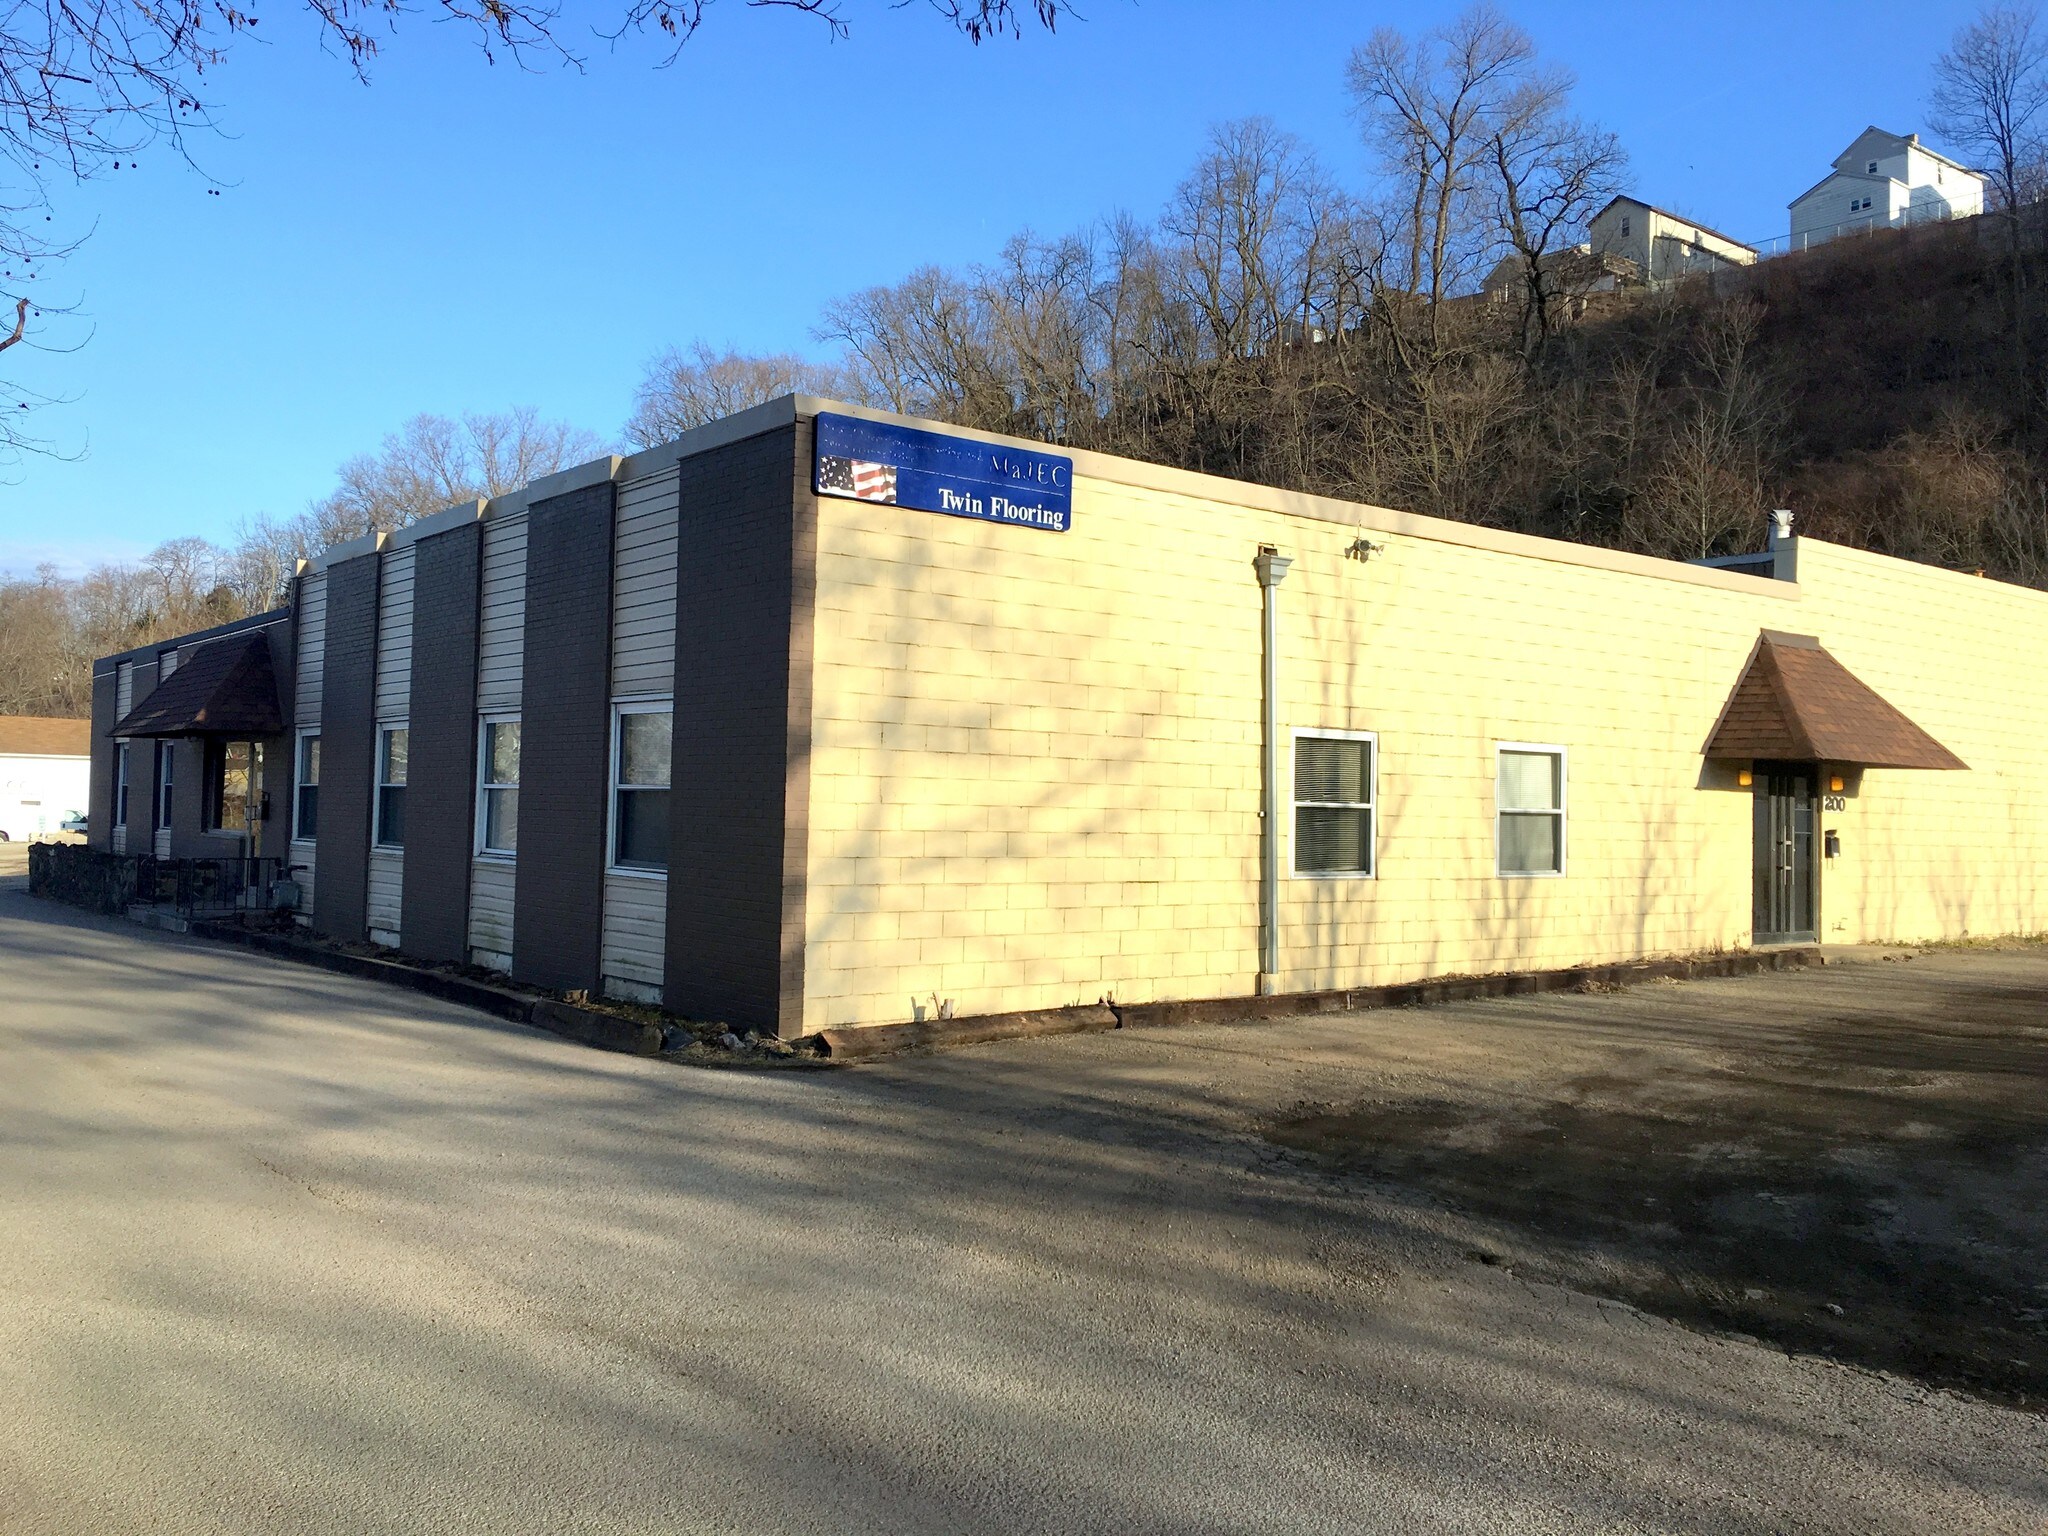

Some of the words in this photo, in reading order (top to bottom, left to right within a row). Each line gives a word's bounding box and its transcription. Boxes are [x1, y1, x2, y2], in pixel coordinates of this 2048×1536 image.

[938, 488, 983, 515] Twin
[991, 497, 1064, 531] Flooring
[1824, 795, 1846, 812] 200
